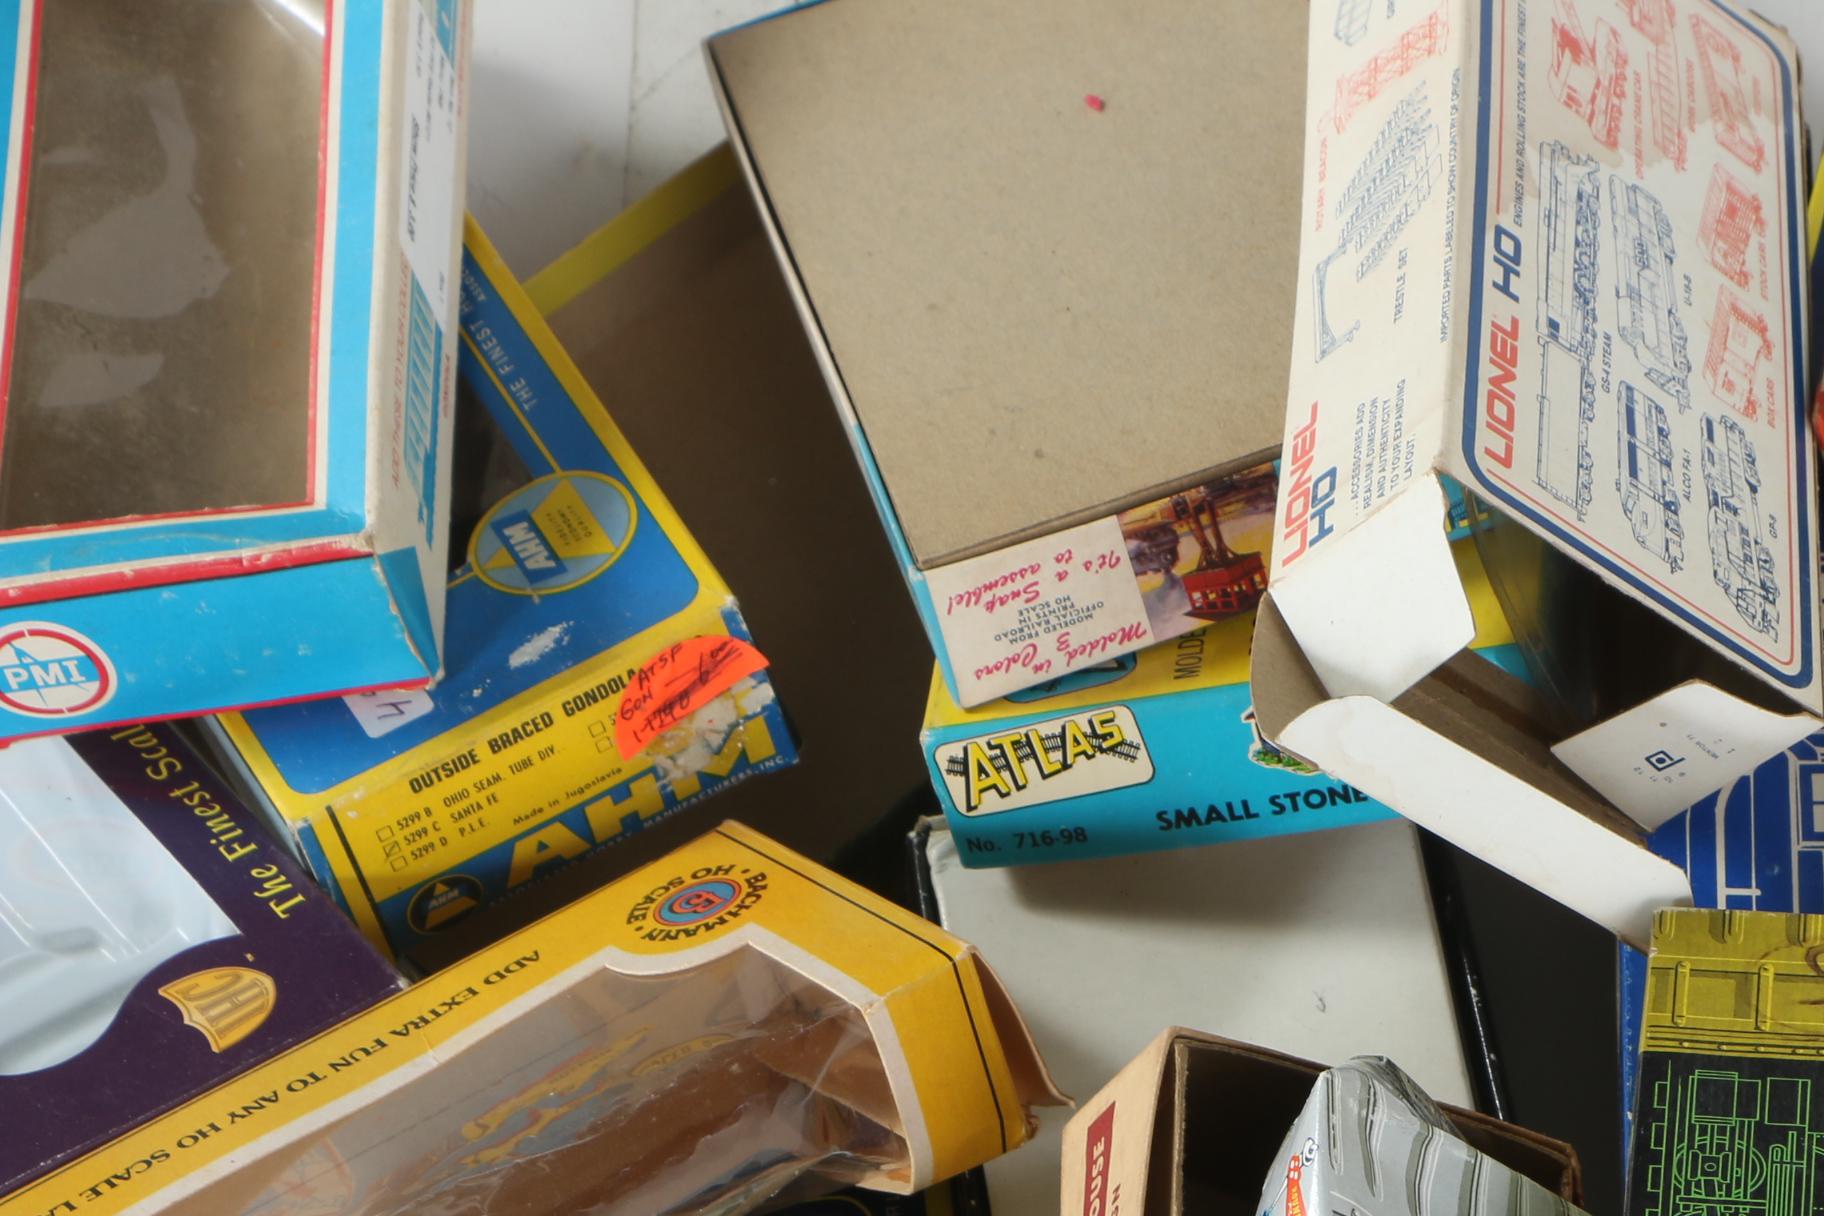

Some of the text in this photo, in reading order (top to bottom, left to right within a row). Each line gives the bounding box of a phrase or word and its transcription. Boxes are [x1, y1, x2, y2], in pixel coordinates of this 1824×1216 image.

[1484, 223, 1522, 469] LIONEL HO
[1281, 401, 1318, 567] LIONEL
[1308, 465, 1337, 547] HO
[503, 521, 556, 569] AHM
[1054, 549, 1120, 582] It's a
[946, 548, 1072, 615] to assemble!
[979, 580, 1039, 613] Snap
[974, 631, 1070, 680] 3 Colors
[1031, 621, 1150, 674] Molded in
[5, 659, 85, 690] PMI
[409, 668, 643, 793] OUTSIDE BRACED GONDOLA
[956, 707, 1130, 813] ATLAS
[110, 711, 305, 918] The Finest Scal
[450, 793, 498, 823] SANTA FE
[507, 716, 776, 888] AHM
[1155, 779, 1369, 834] SMALL STONE
[966, 823, 1088, 853] No. 716-98
[626, 864, 736, 925] HO SCALE
[641, 872, 768, 941] BACHMANN
[482, 949, 539, 984] ADD
[388, 986, 476, 1036] EXTRA
[327, 1037, 387, 1072] FUN
[227, 1089, 278, 1124] ANY
[285, 1071, 323, 1092] TO
[176, 1122, 221, 1148] HO
[78, 1149, 169, 1201] SCALE
